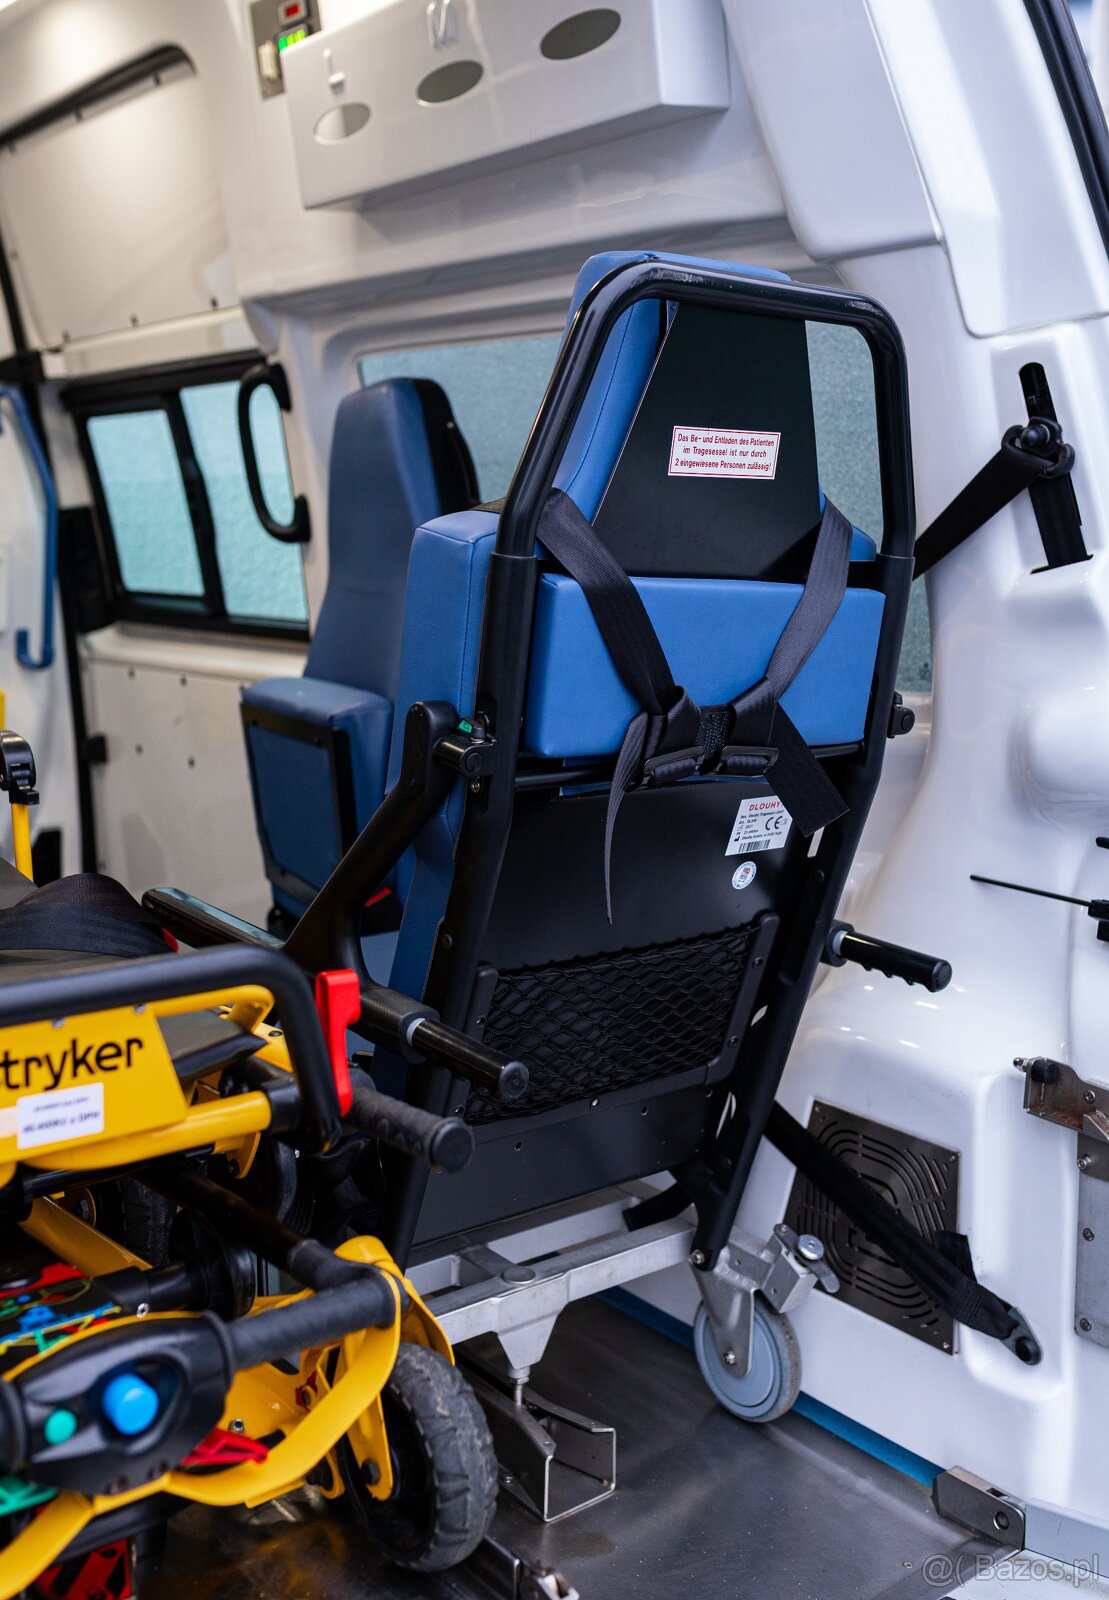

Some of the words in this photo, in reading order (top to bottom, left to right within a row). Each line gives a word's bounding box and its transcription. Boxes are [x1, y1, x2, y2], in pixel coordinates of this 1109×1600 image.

[678, 434, 688, 442] Das
[690, 434, 701, 442] Be-
[703, 436, 713, 444] und
[714, 436, 737, 445] Entladen
[739, 438, 749, 446] des
[750, 438, 774, 446] Patienten
[683, 446, 690, 454] im
[693, 446, 727, 456] Tragesessel
[729, 448, 737, 456] ist
[750, 450, 766, 458] durch
[675, 458, 679, 466] 2
[680, 460, 718, 468] eingewiesene
[720, 461, 746, 469] Personen
[747, 462, 772, 471] zulässig!
[749, 802, 780, 811] DLOUHY
[765, 816, 782, 830] CE
[0, 1037, 144, 1091] tryker
